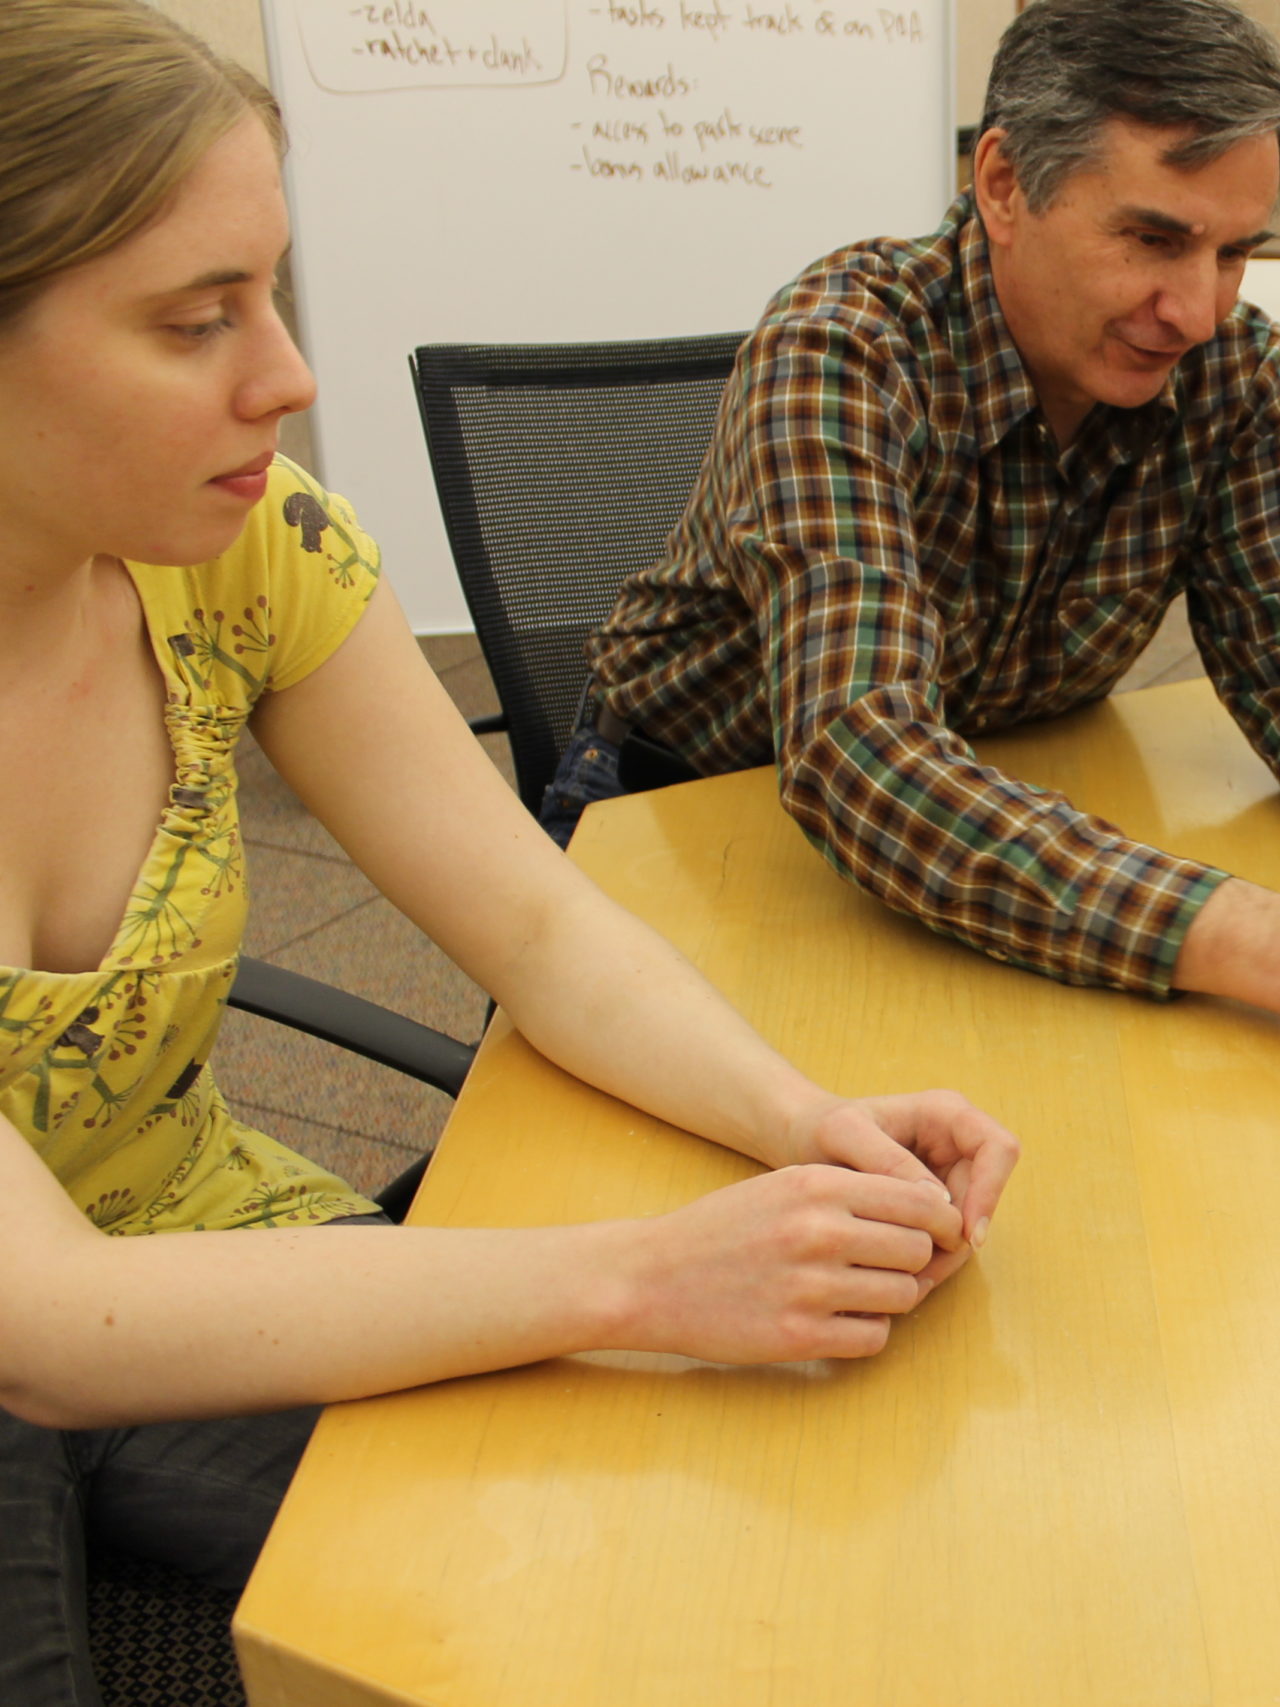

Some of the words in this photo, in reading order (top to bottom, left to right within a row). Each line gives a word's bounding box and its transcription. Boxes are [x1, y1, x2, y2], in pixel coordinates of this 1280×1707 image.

[679, 0, 731, 42] kept
[742, 3, 803, 35] track
[657, 108, 684, 137] to
[653, 150, 773, 189] allowance
